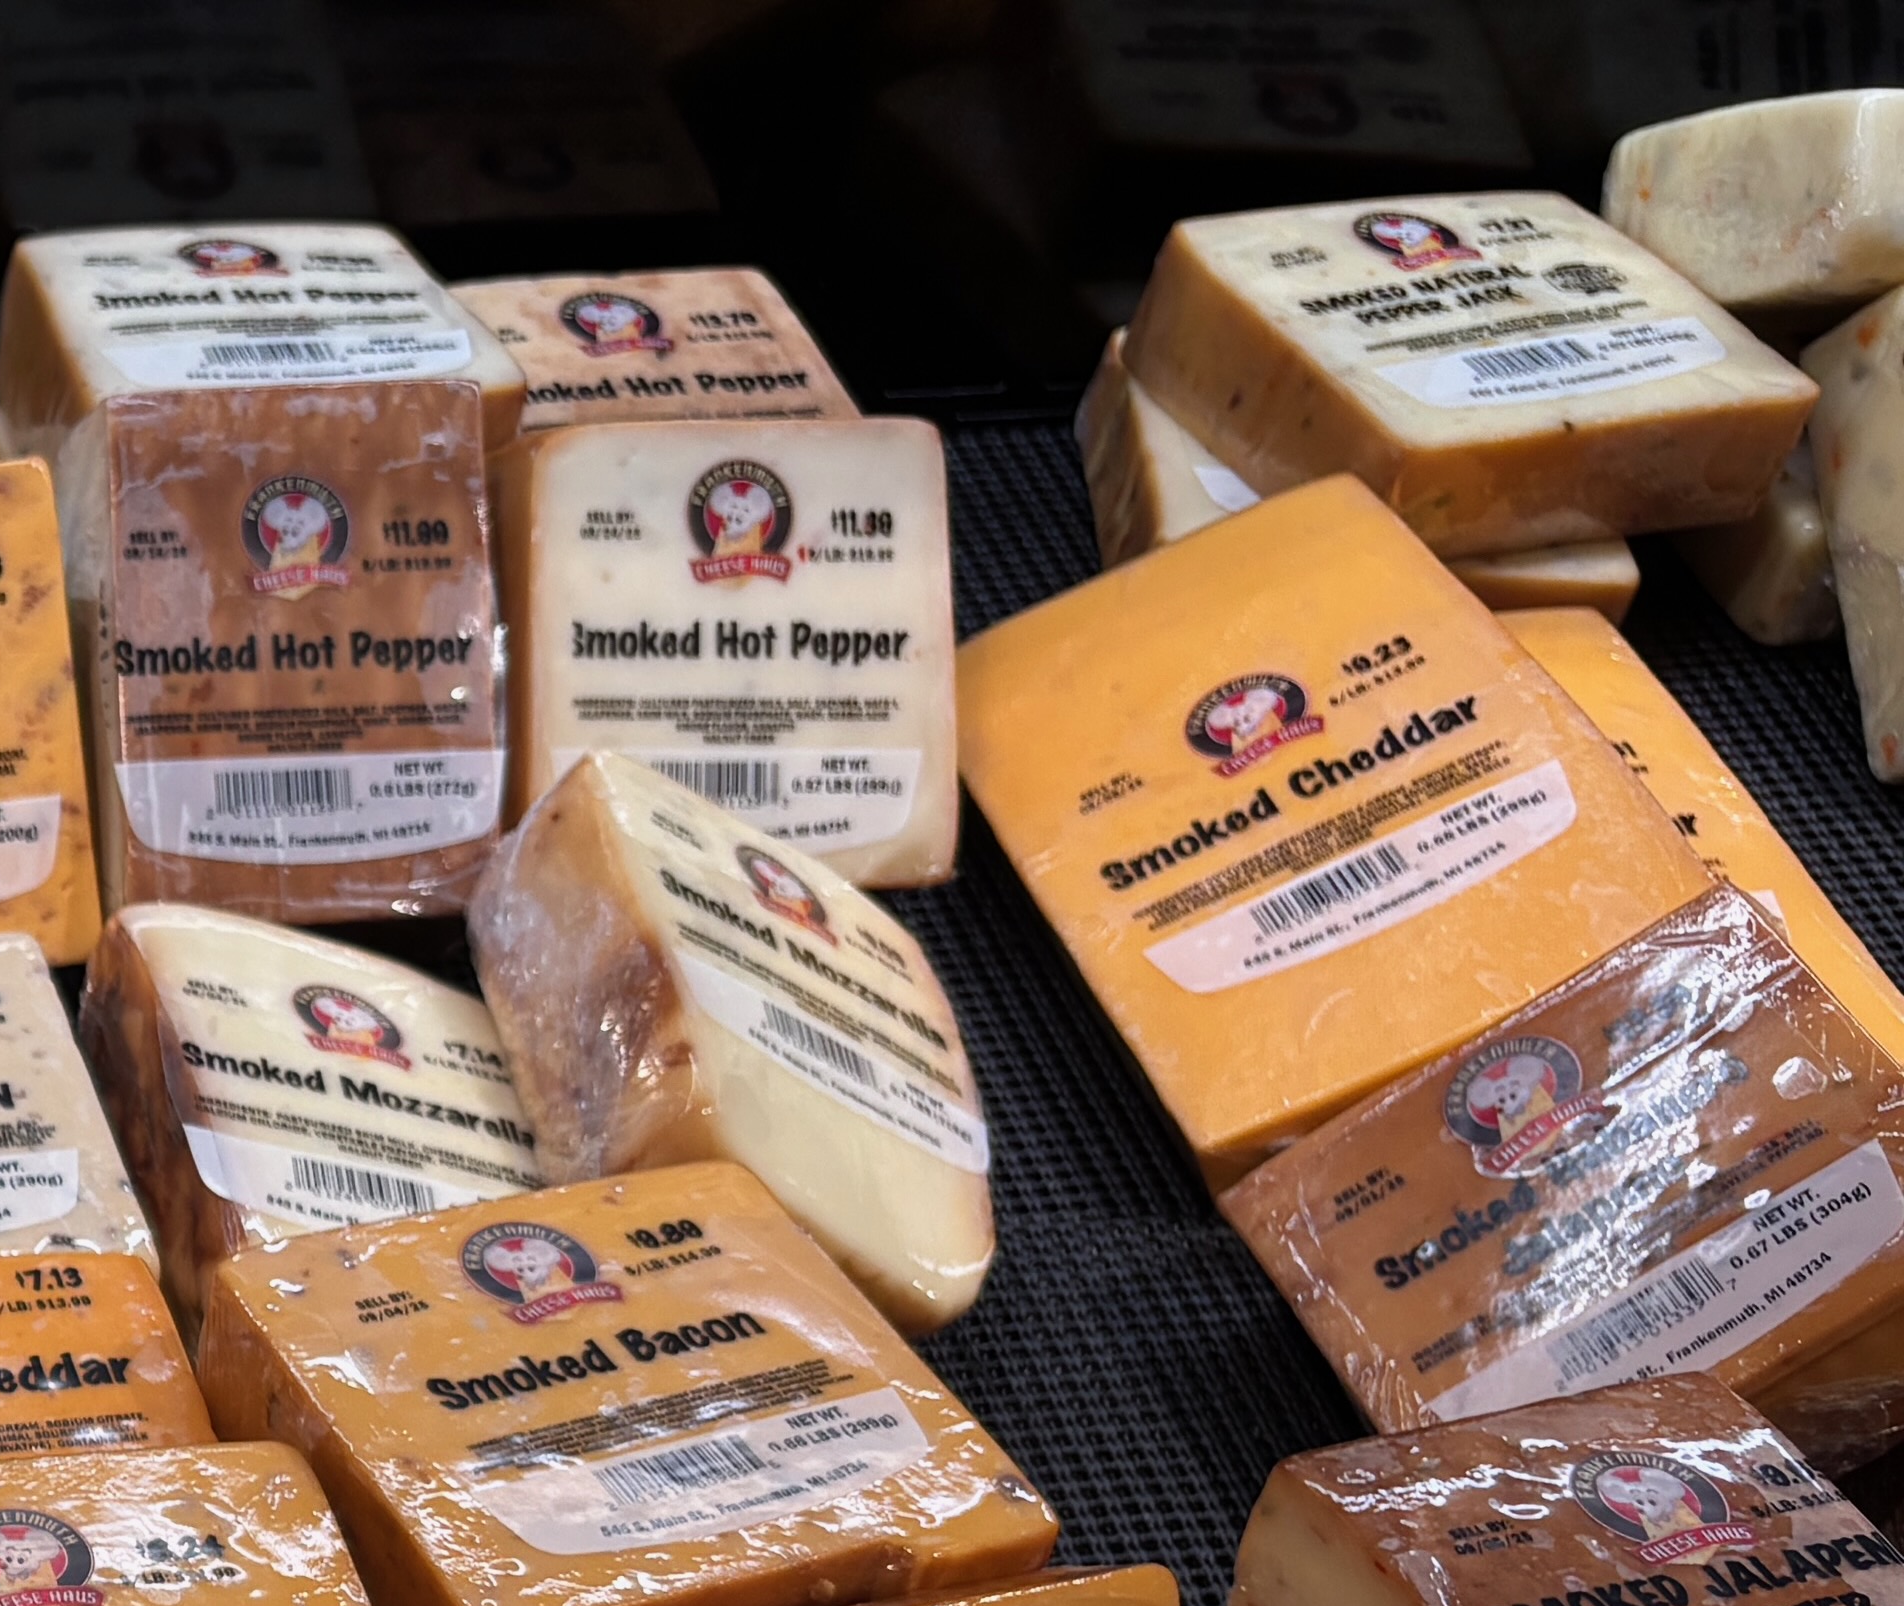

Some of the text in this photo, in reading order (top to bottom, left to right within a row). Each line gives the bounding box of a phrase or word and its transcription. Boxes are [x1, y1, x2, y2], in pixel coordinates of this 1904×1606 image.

[114, 631, 474, 677] Smoked Hot Pepper
[717, 622, 777, 659] Hot
[792, 623, 909, 664] Pepper
[1100, 692, 1482, 893] Smoked Cheddar
[659, 868, 781, 952] Smoked
[181, 1041, 538, 1150] Smoked Mozzarella
[1374, 1177, 1539, 1292] Smoked
[426, 1308, 766, 1412] Smoked Bacon
